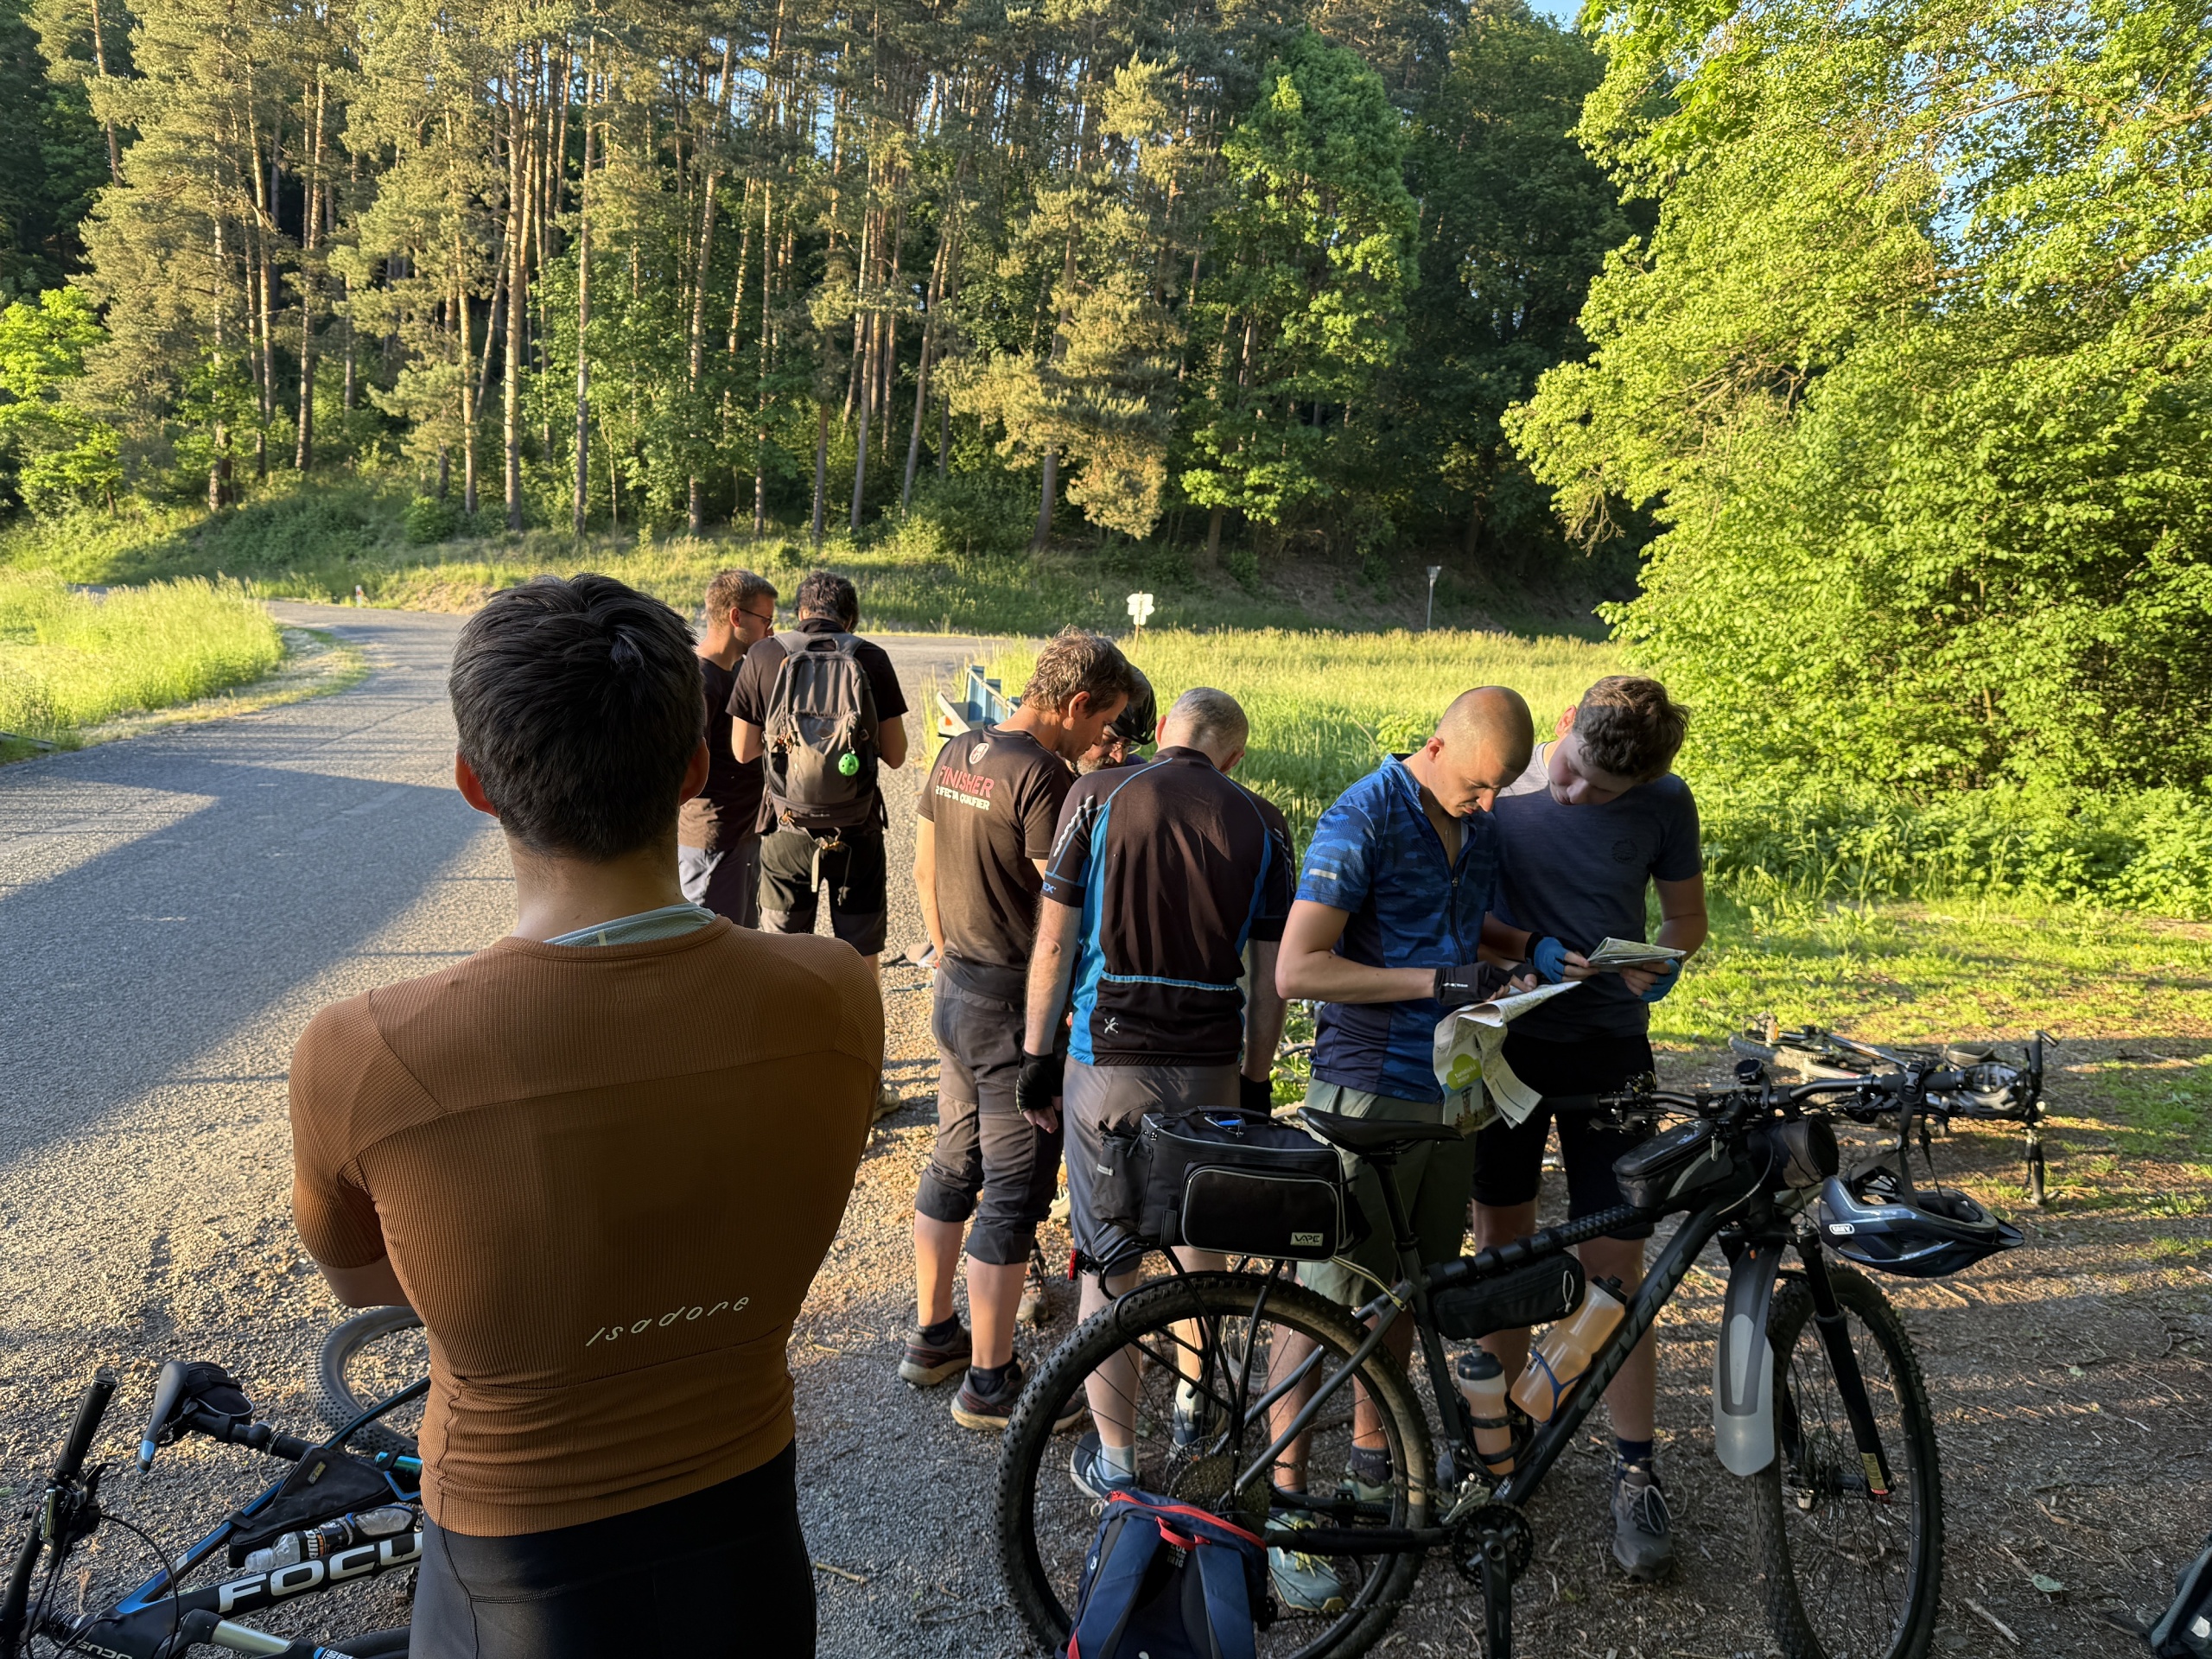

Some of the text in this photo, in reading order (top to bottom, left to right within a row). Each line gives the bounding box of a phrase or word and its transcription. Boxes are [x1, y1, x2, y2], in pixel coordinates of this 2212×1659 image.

[938, 765, 995, 798] FINISHER
[585, 1296, 749, 1347] Isadore
[1578, 1250, 1685, 1410] STEVENS
